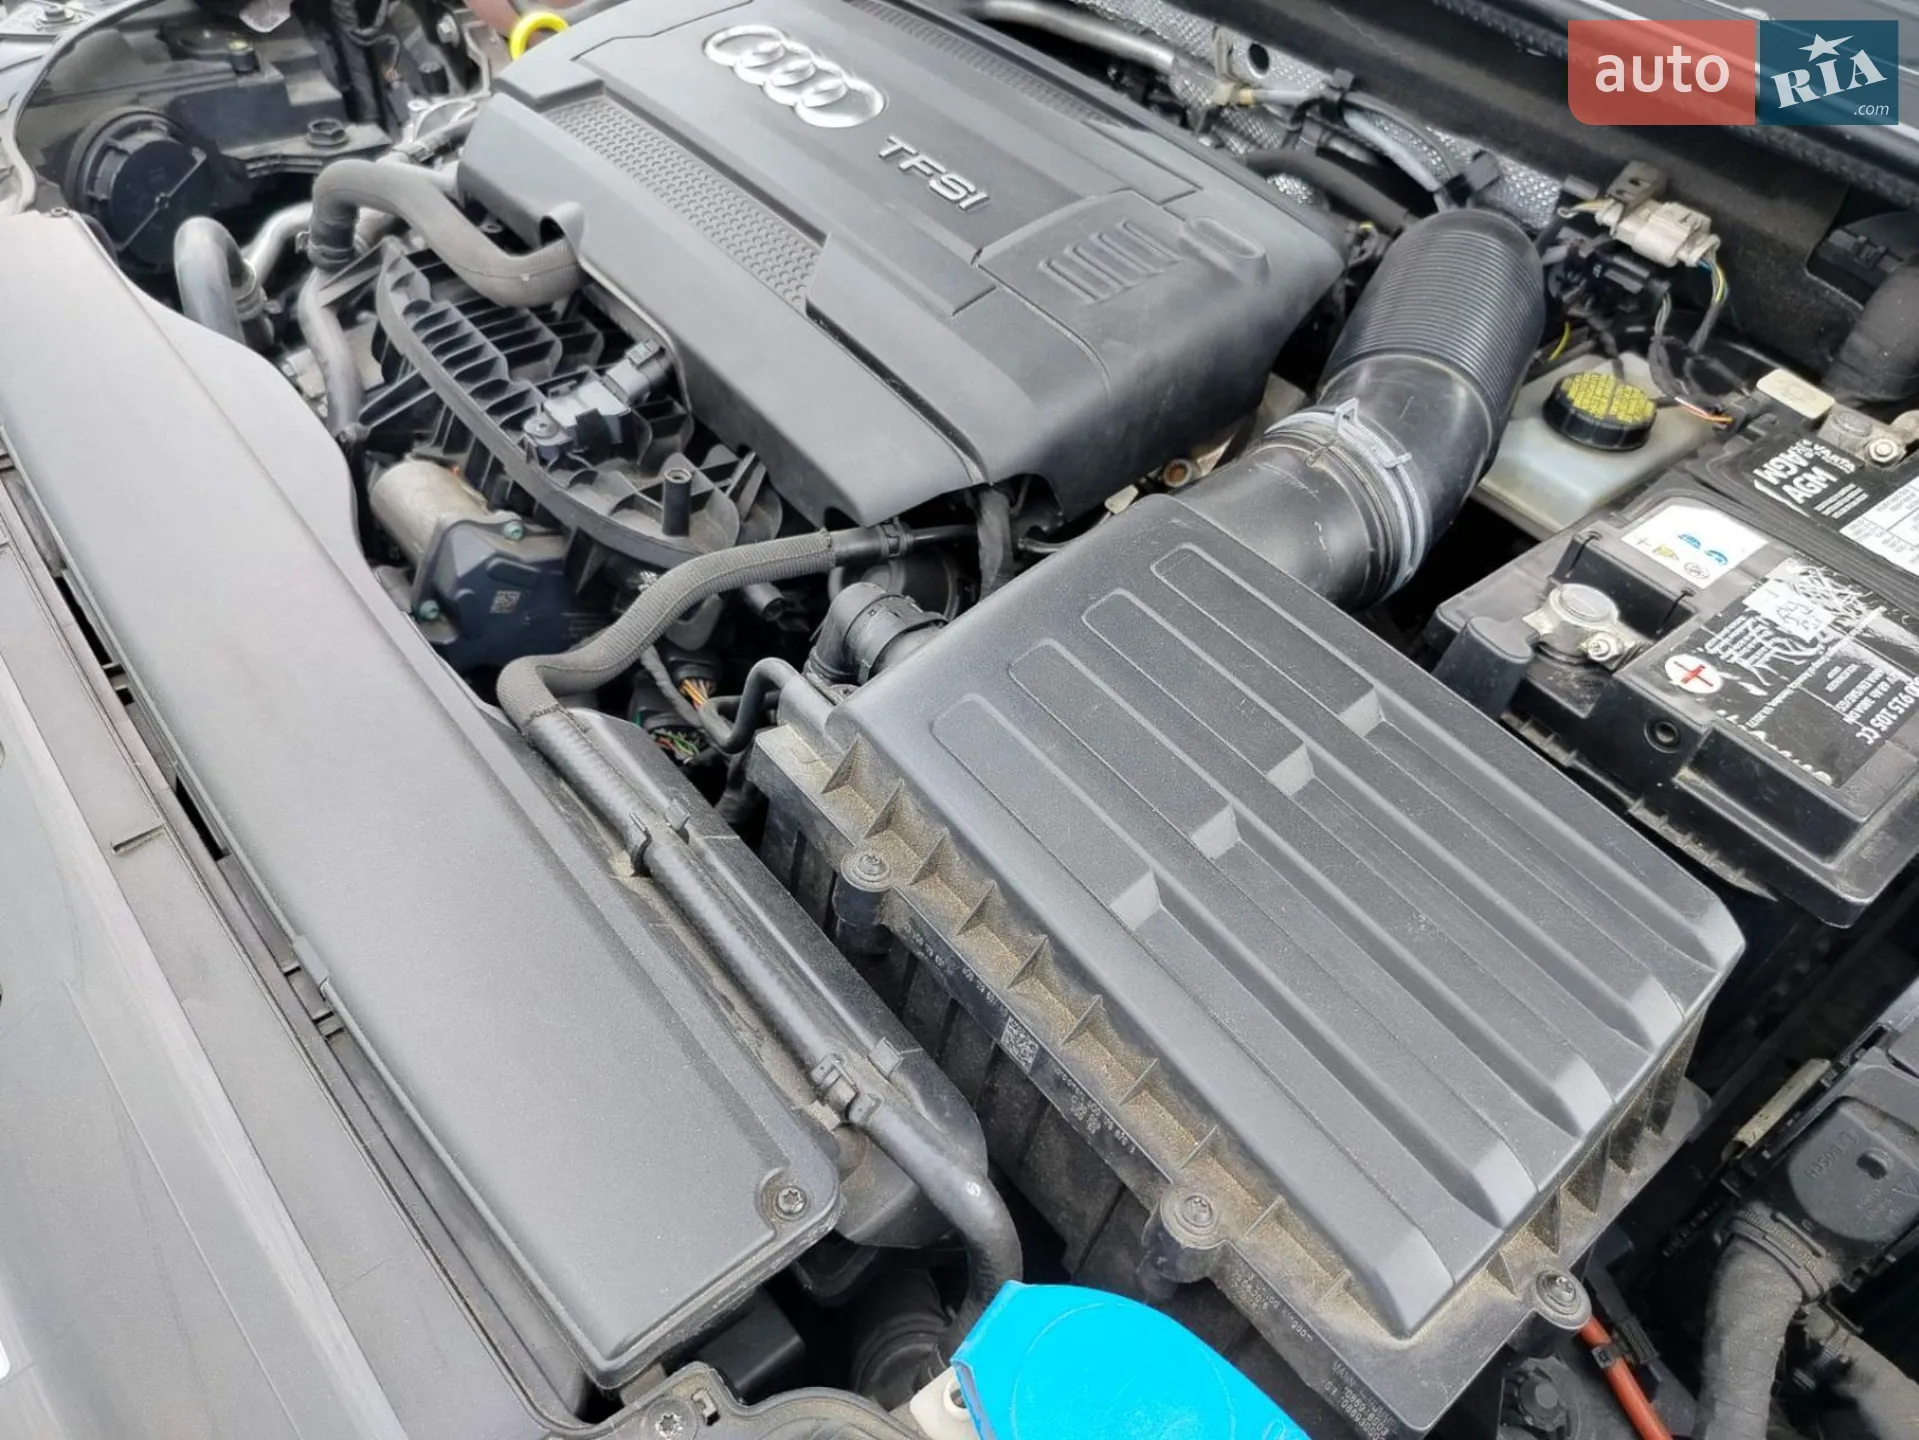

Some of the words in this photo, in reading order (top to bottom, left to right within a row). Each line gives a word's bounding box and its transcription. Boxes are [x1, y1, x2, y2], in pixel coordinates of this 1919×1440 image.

[878, 135, 990, 211] TFSI
[1782, 466, 1838, 504] AGM
[1887, 692, 1915, 714] 915
[1869, 707, 1898, 731] 105
[1855, 726, 1881, 744] CC
